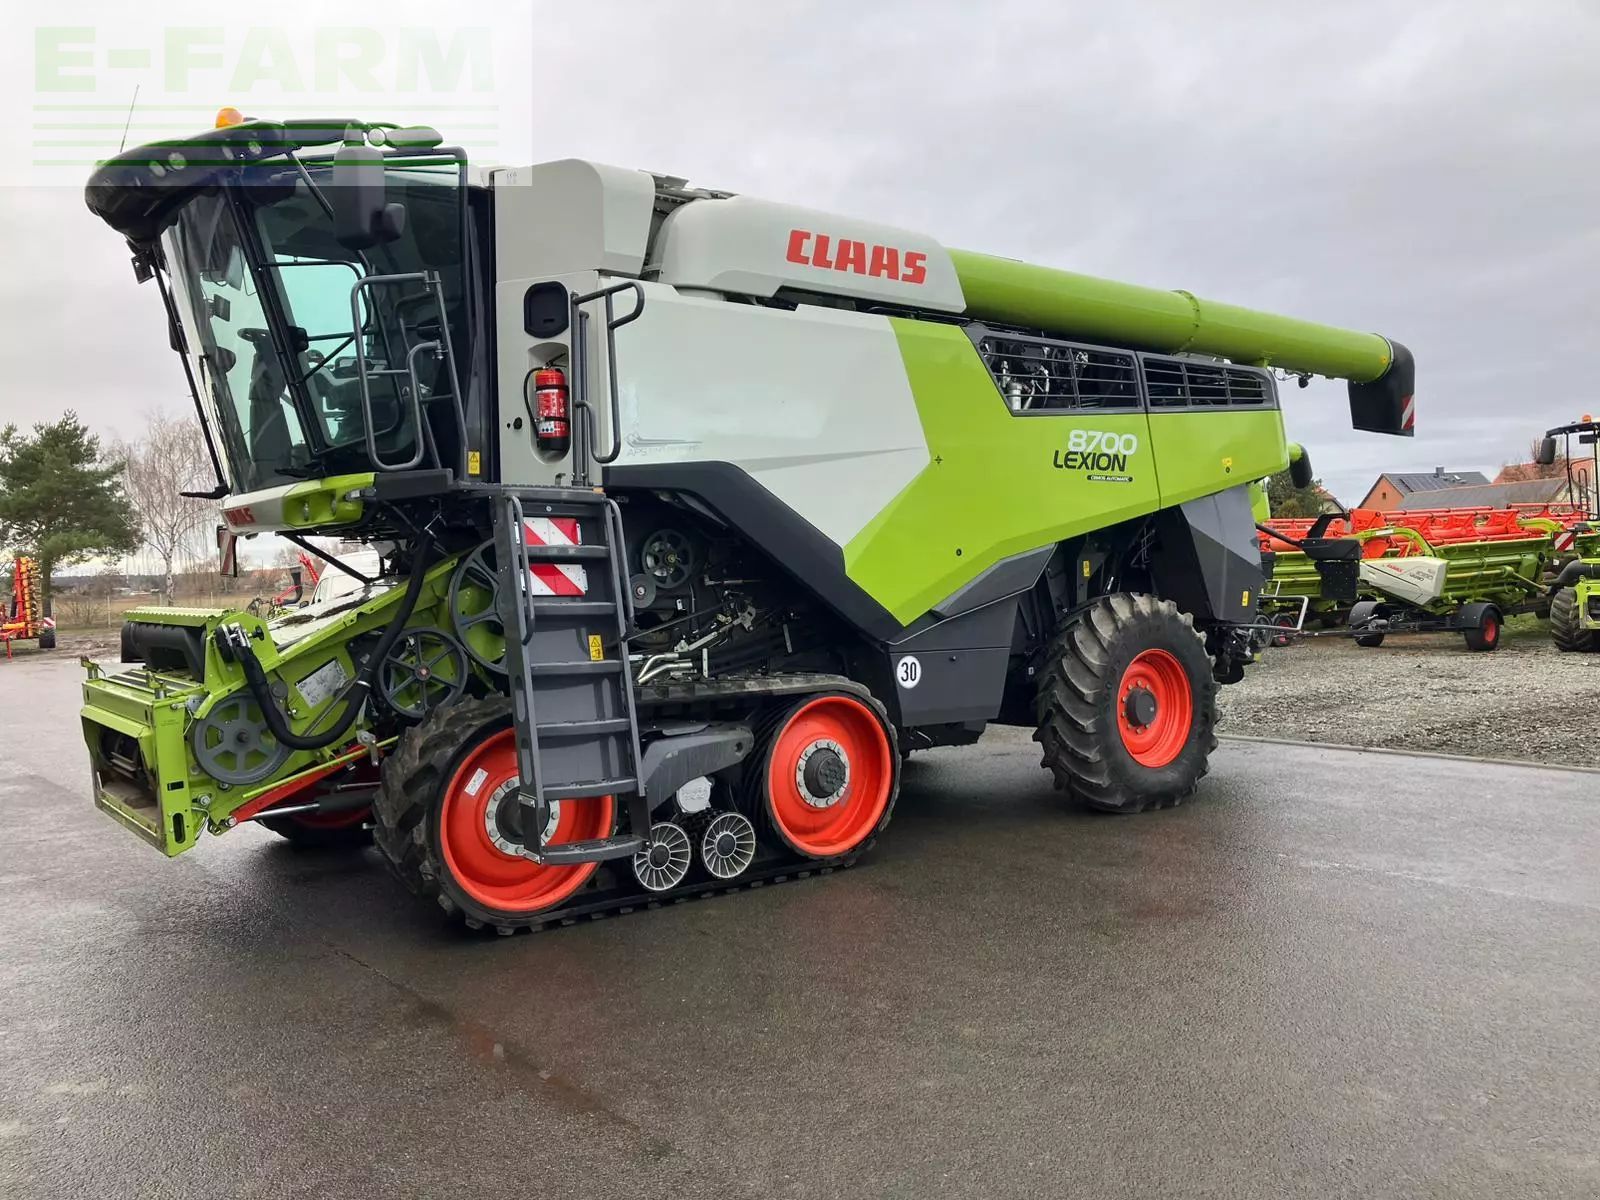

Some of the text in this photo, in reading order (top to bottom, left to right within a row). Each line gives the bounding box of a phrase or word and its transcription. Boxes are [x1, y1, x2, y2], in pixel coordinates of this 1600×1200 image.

[785, 228, 928, 285] CLAAS
[1067, 429, 1138, 456] 8700
[1053, 450, 1127, 472] LEXION
[900, 661, 917, 682] 30
